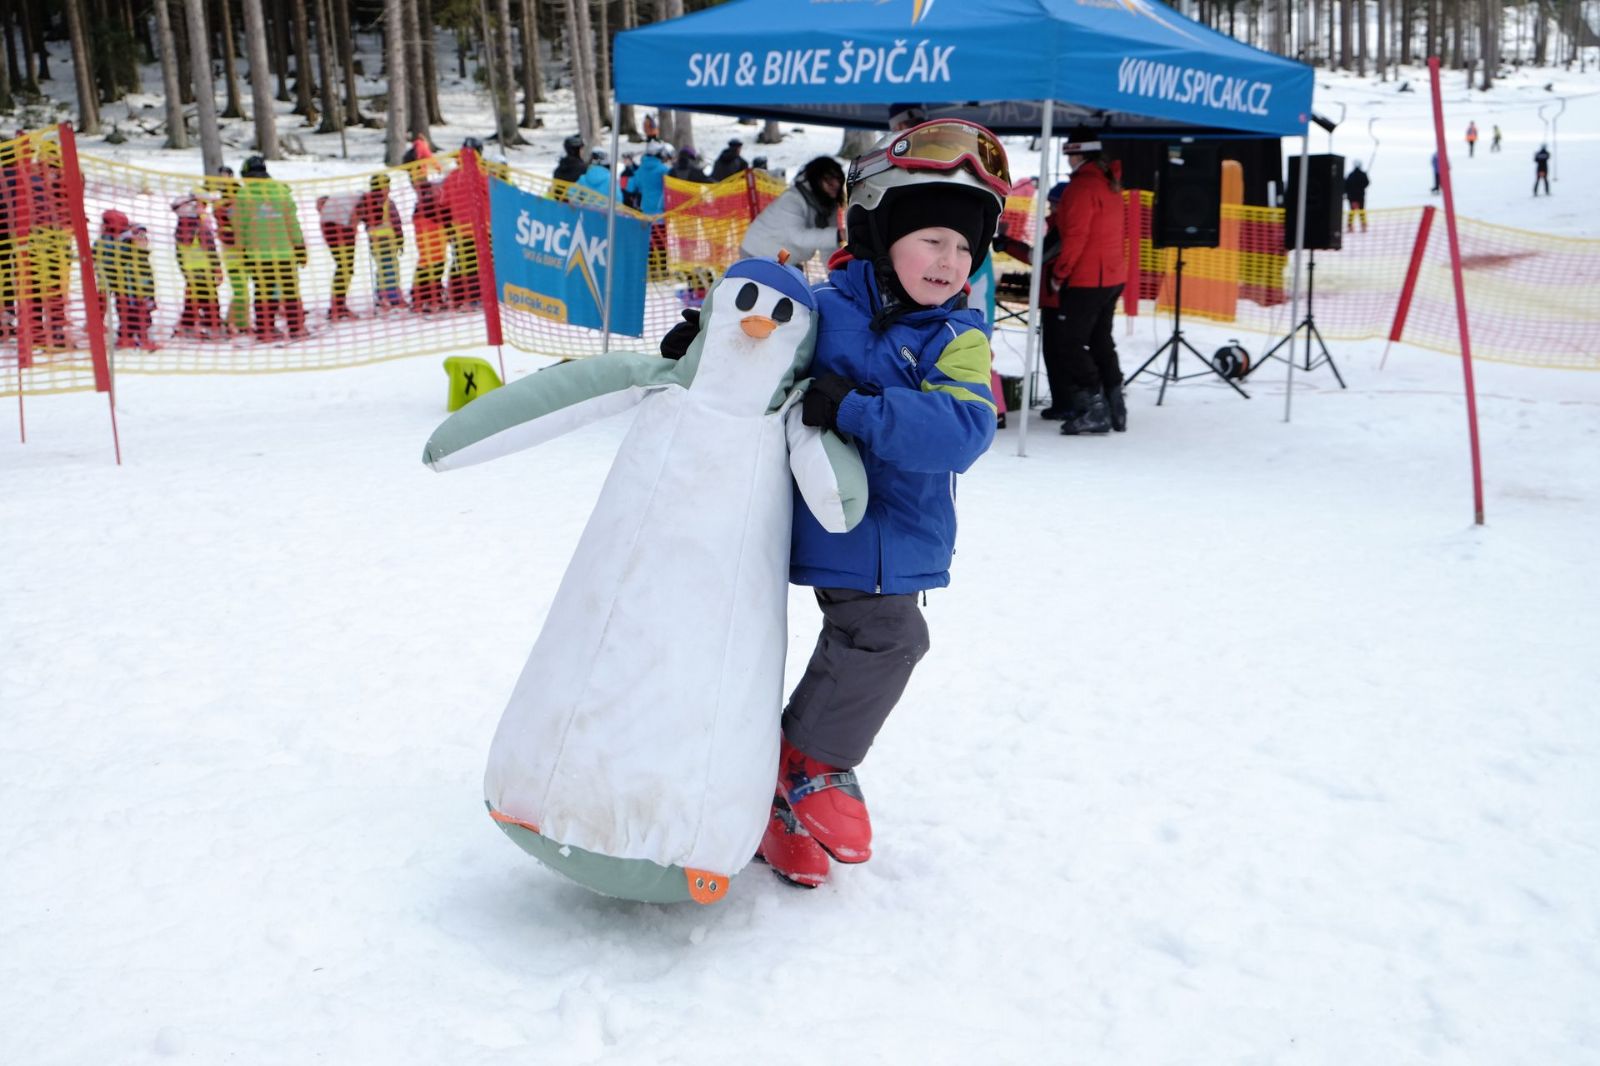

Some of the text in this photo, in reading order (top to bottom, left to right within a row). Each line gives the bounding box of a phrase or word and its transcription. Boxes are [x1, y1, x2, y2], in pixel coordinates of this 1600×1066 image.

[686, 39, 955, 87] SKI & BIKE ŠPIČÁK
[1118, 57, 1272, 116] WWW.SPICAK.CZ
